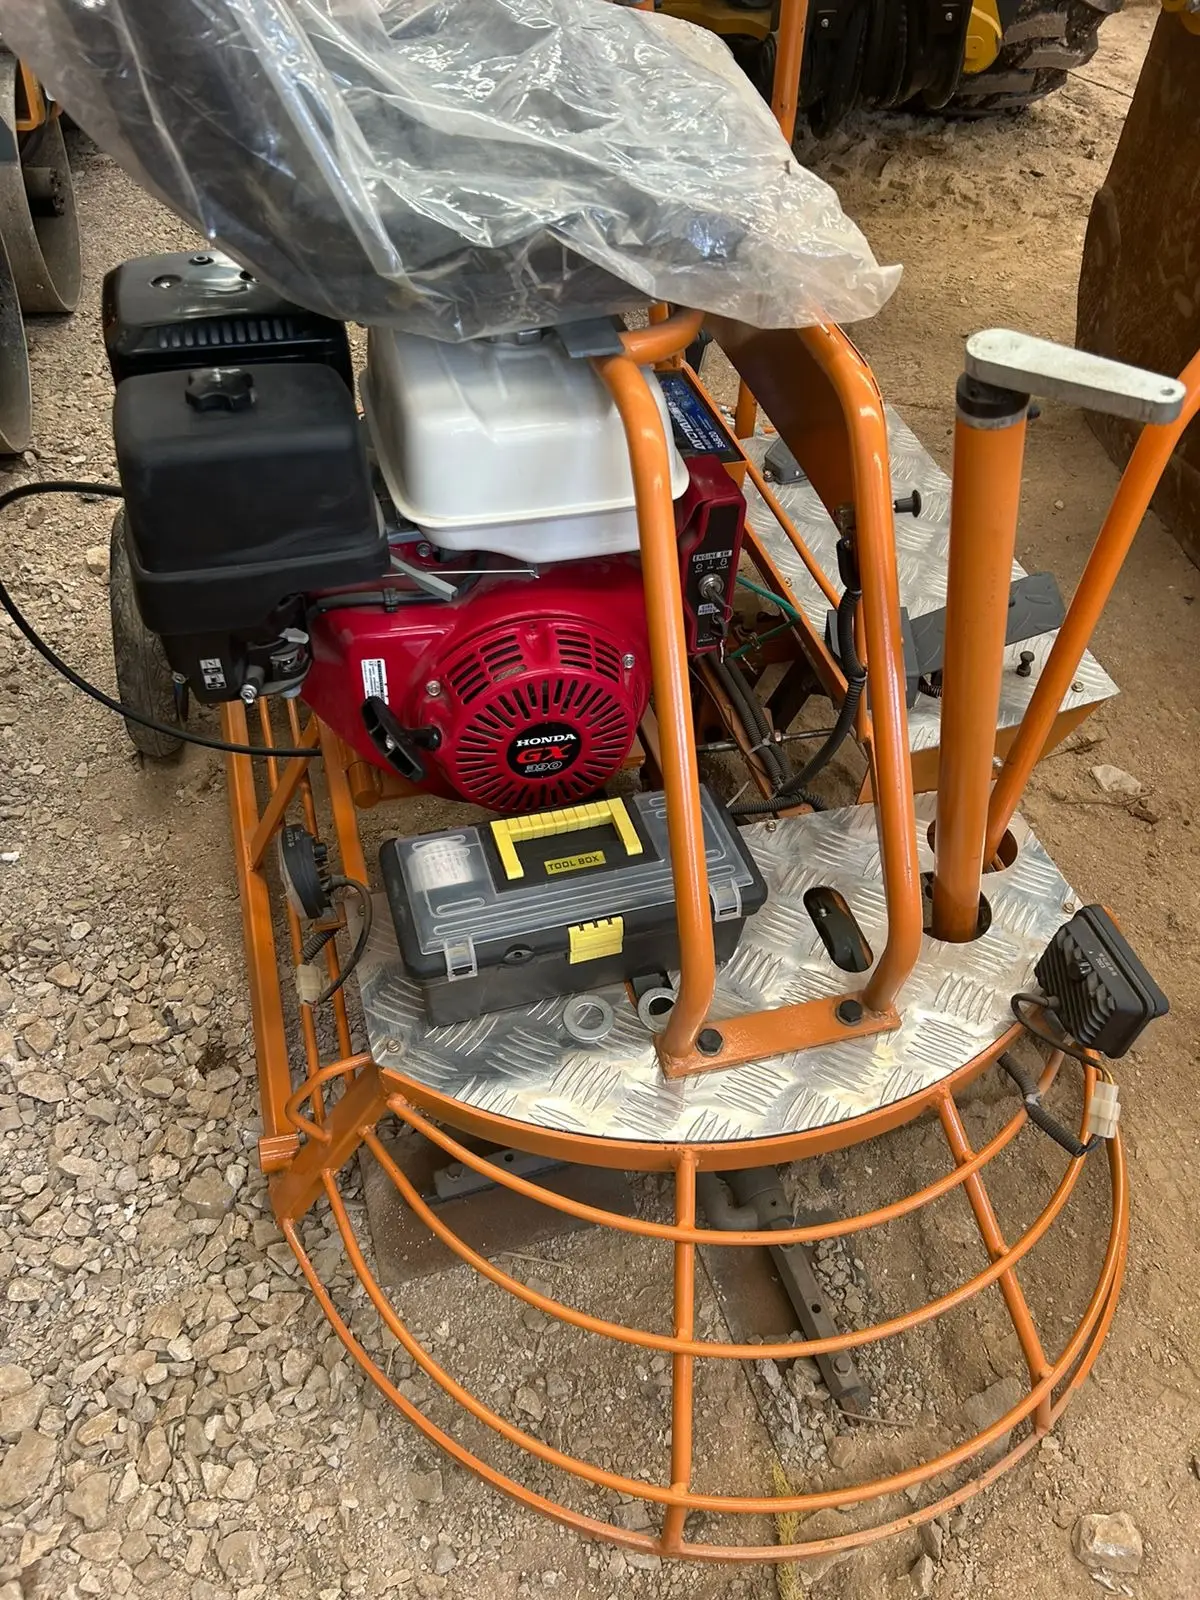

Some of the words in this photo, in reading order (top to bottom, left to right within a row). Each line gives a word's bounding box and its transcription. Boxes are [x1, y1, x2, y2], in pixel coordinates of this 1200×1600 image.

[693, 552, 718, 561] ENGINE
[516, 733, 577, 747] HONDA
[516, 744, 573, 764] GX
[524, 760, 563, 774] 390
[547, 861, 577, 871] TOOL
[577, 855, 600, 865] BOX
